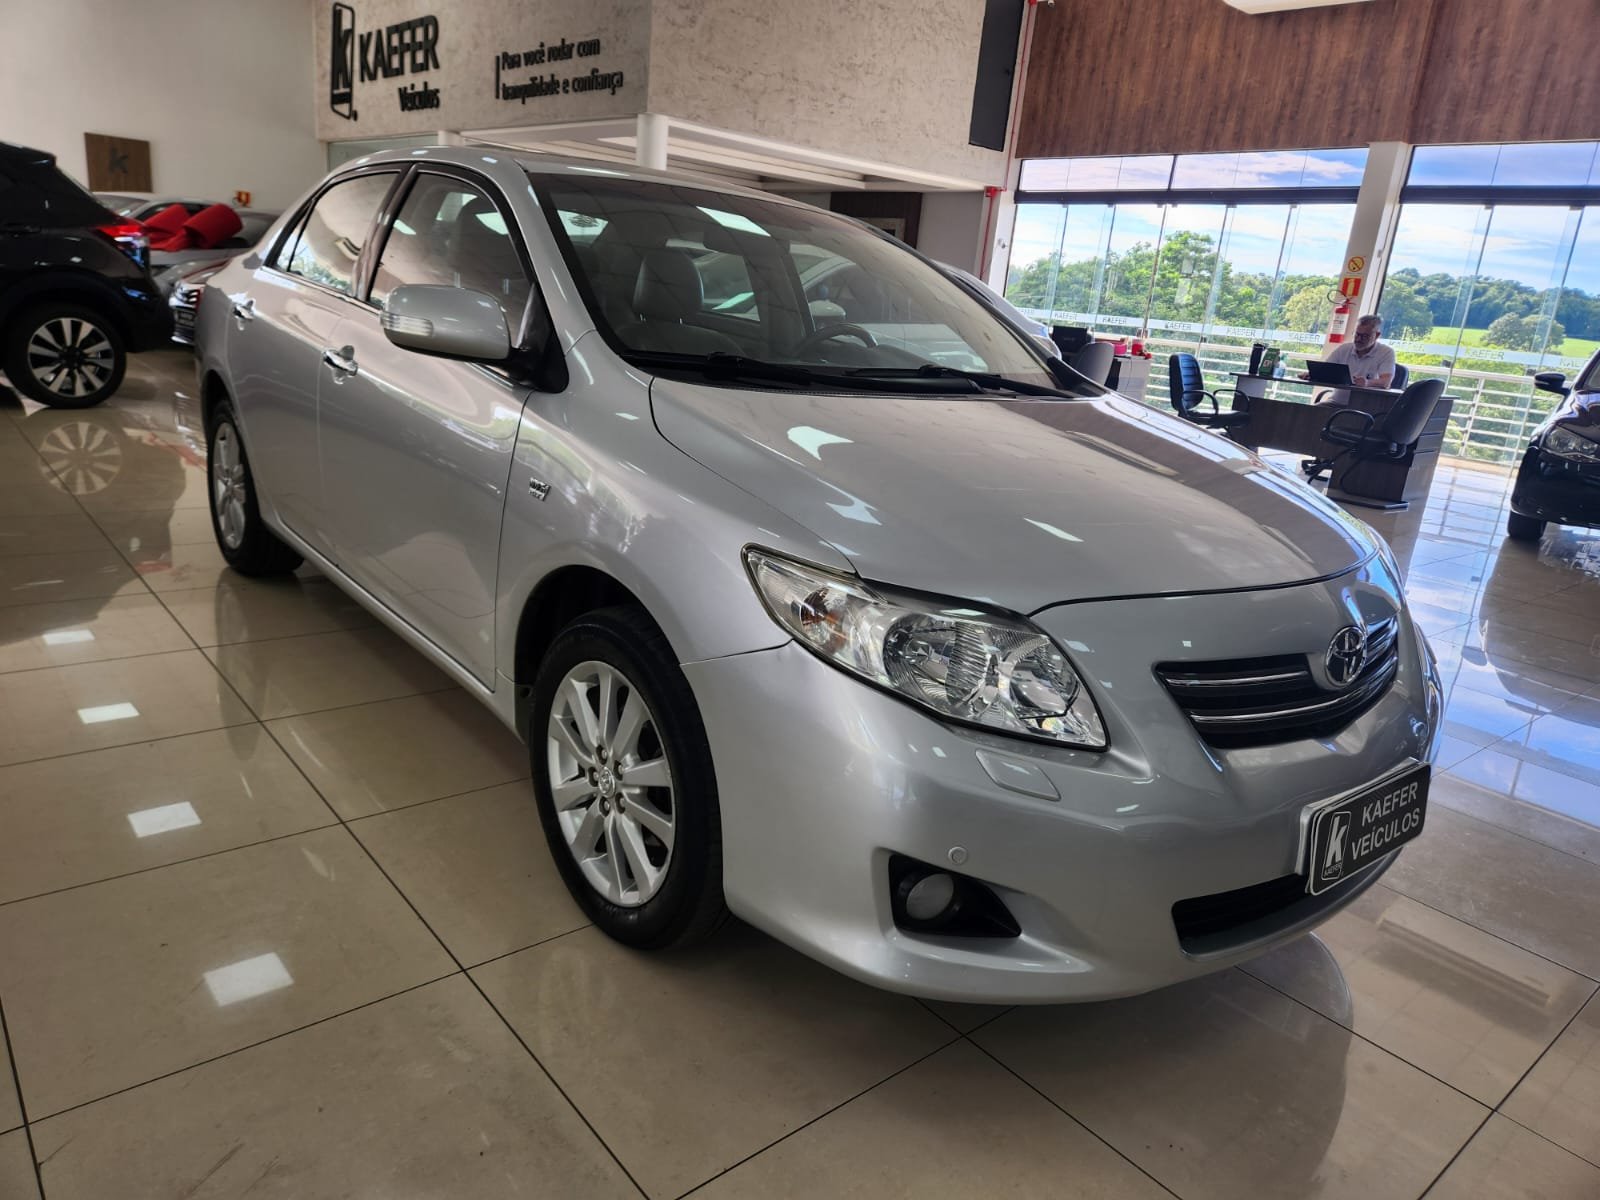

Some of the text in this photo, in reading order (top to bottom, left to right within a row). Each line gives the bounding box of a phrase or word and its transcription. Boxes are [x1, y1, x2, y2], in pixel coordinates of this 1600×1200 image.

[359, 15, 440, 82] KAEFER
[577, 39, 601, 57] com
[572, 68, 624, 95] confiança
[1362, 782, 1418, 827] KAEFER
